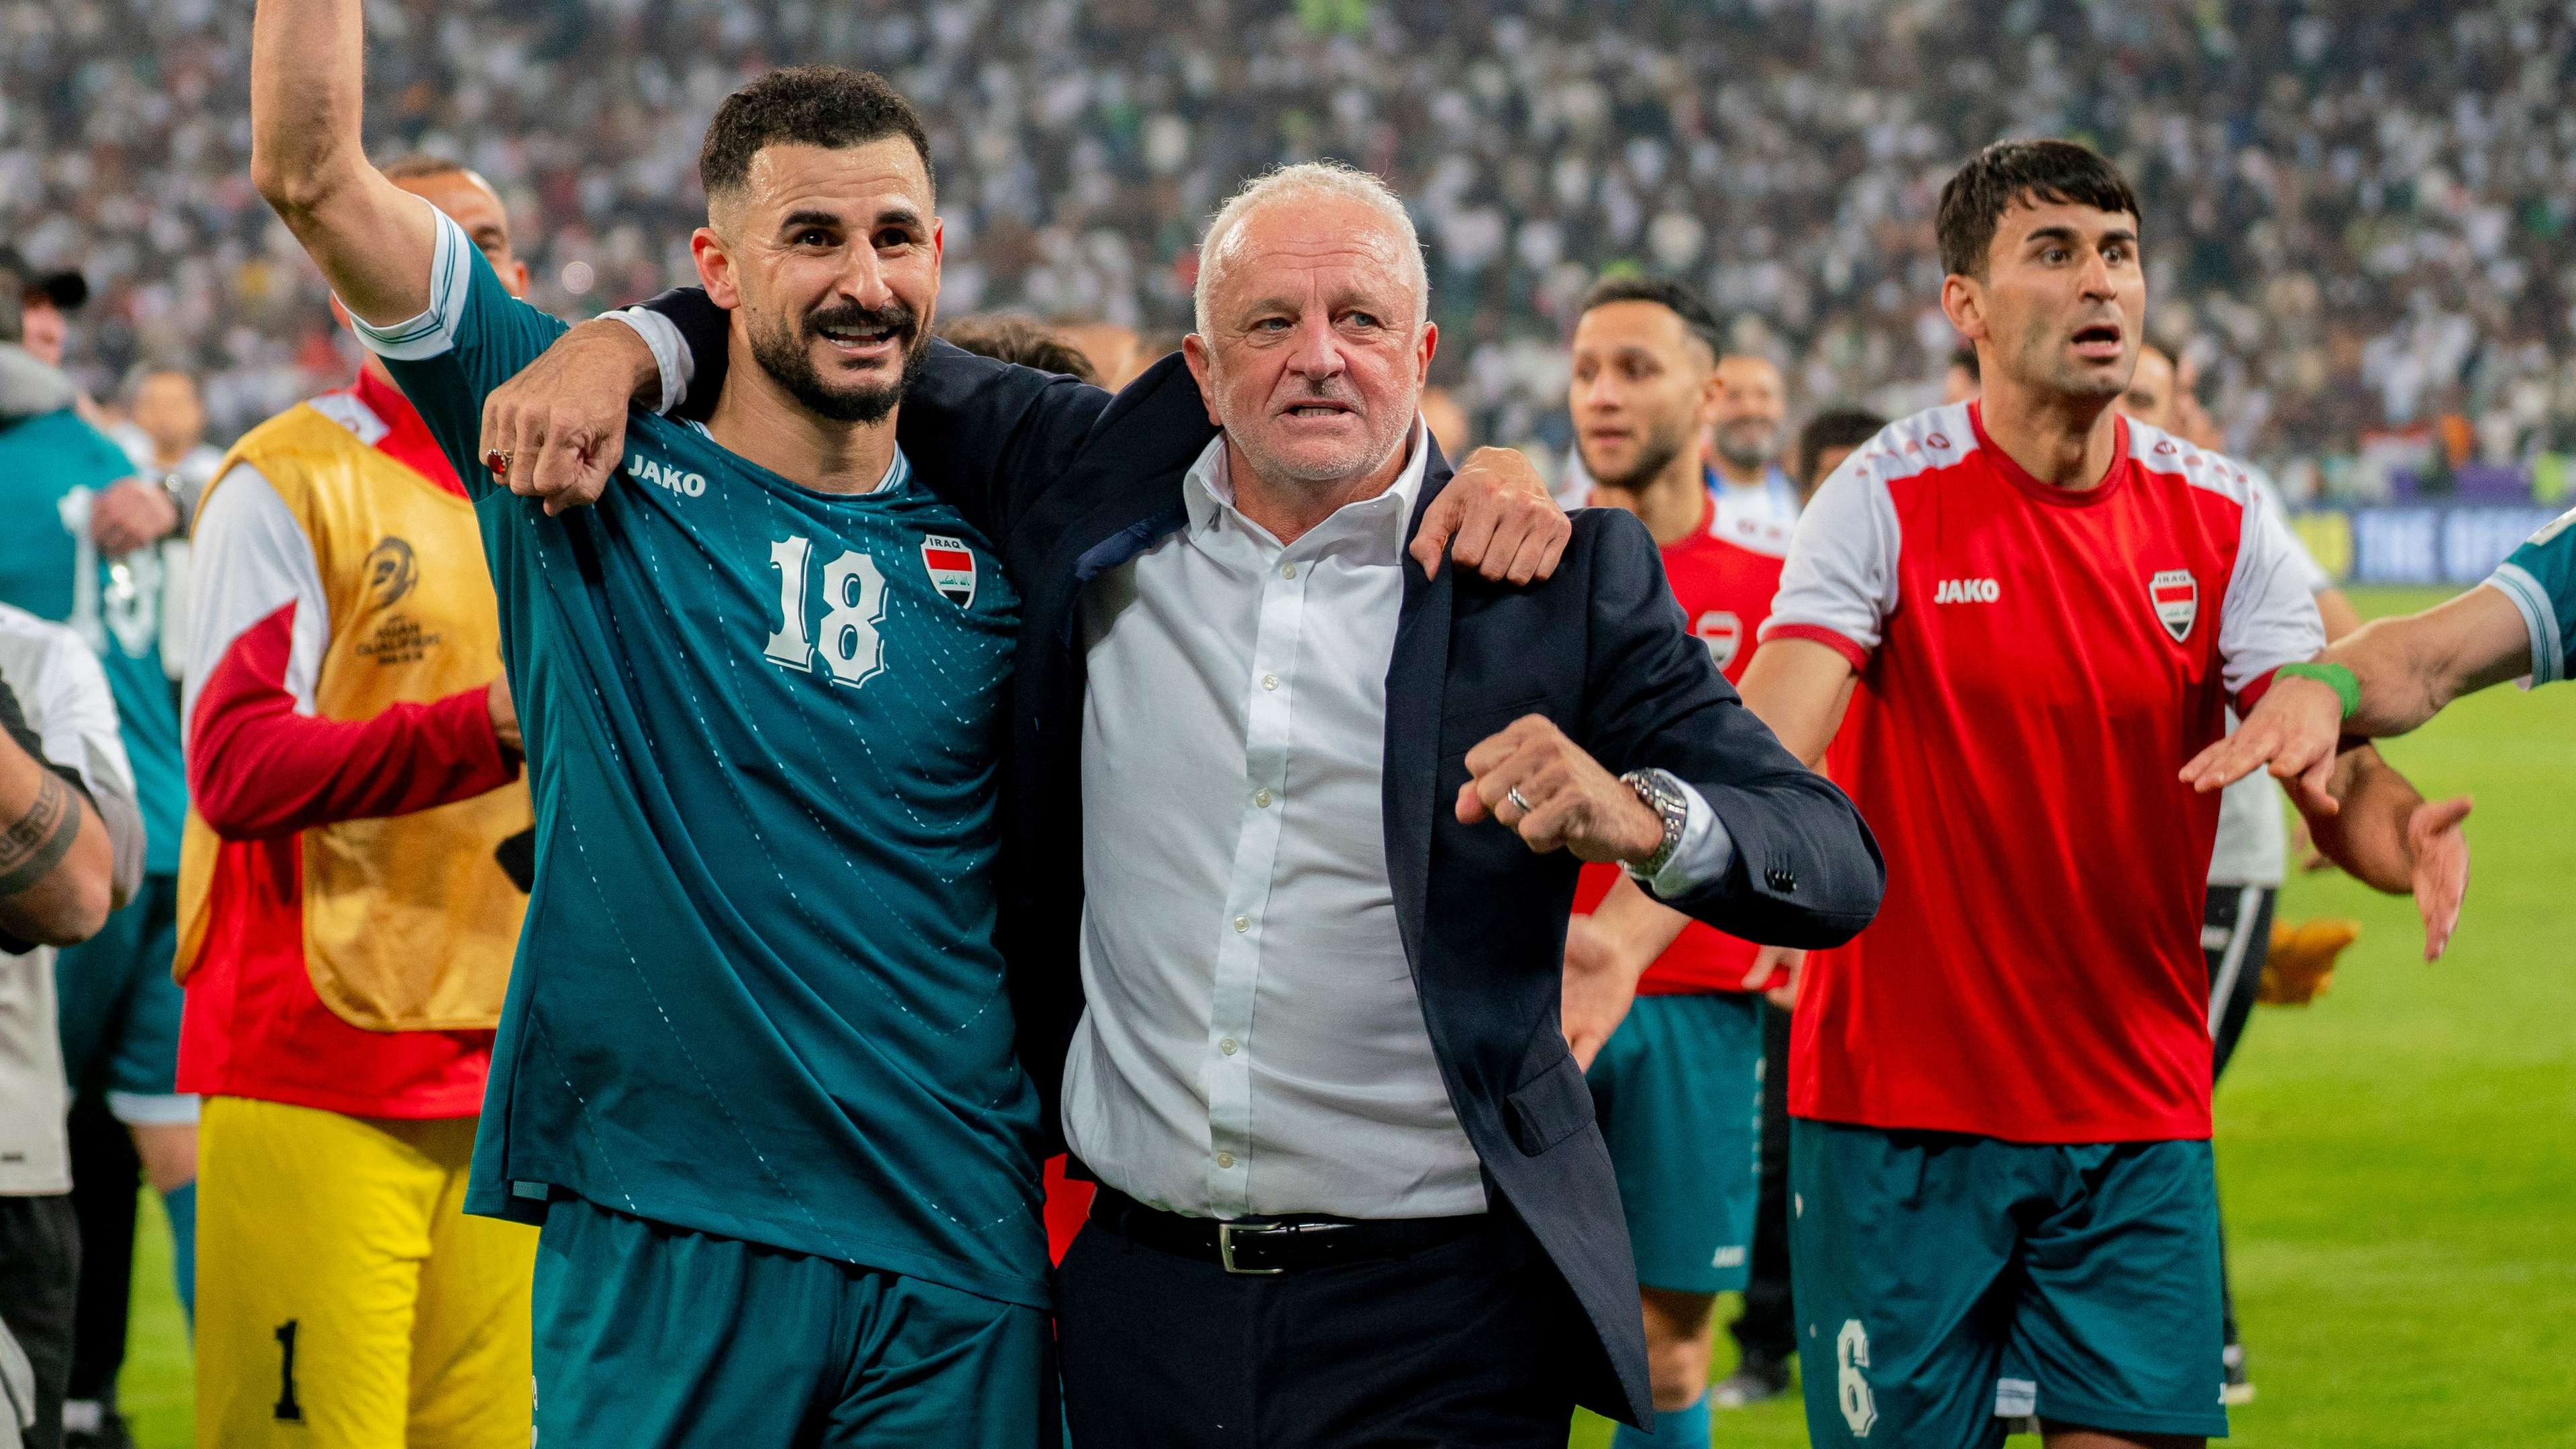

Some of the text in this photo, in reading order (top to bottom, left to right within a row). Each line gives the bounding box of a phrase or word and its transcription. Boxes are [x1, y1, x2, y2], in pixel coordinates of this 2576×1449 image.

[628, 454, 705, 497] JAKO
[929, 538, 961, 549] IRAQ
[763, 535, 888, 689] 18
[1934, 578, 2000, 604] JAKO
[274, 1319, 305, 1425] 1
[1837, 1319, 1878, 1438] 6
